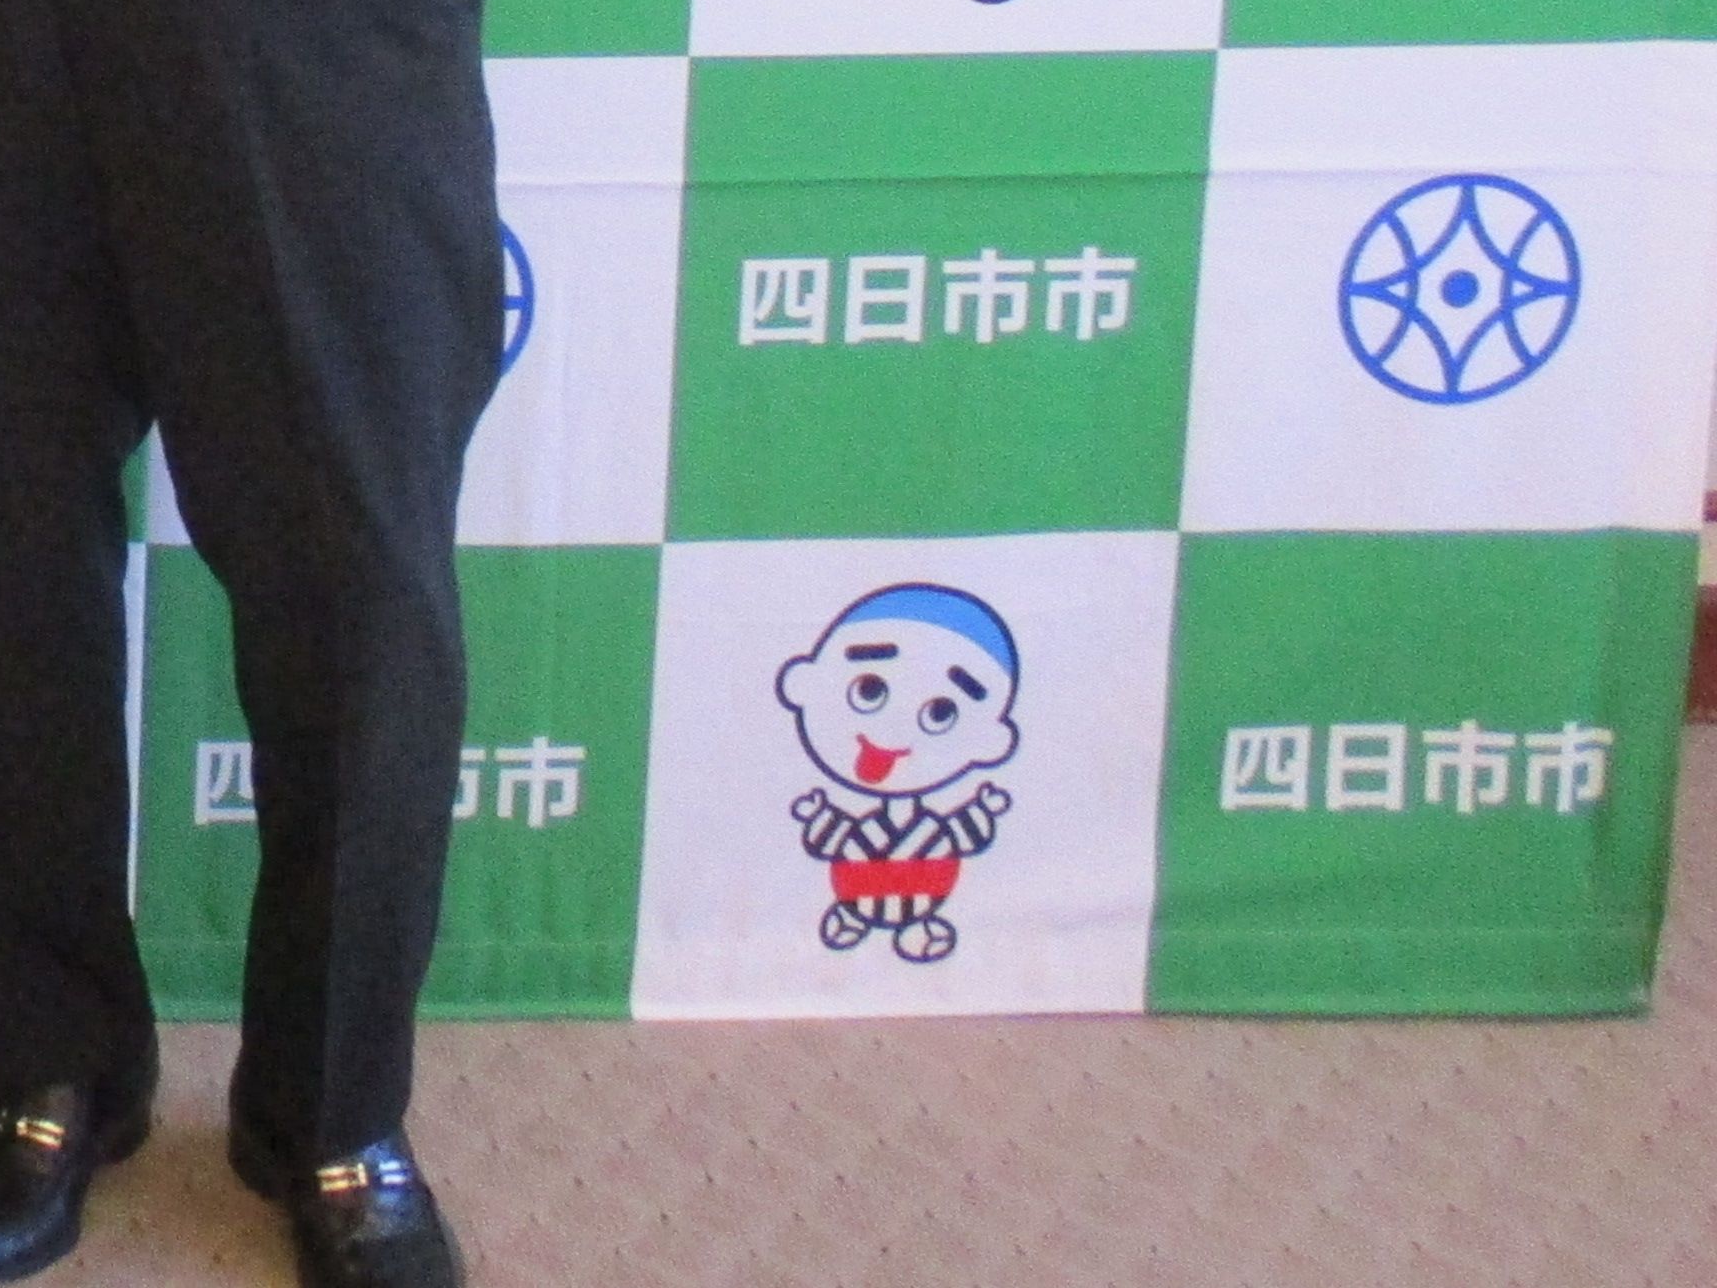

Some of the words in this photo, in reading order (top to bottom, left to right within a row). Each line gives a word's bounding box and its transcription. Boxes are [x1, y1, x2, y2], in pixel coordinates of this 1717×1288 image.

[739, 247, 1137, 345] 四日市市
[1220, 719, 1614, 814] 四日市市
